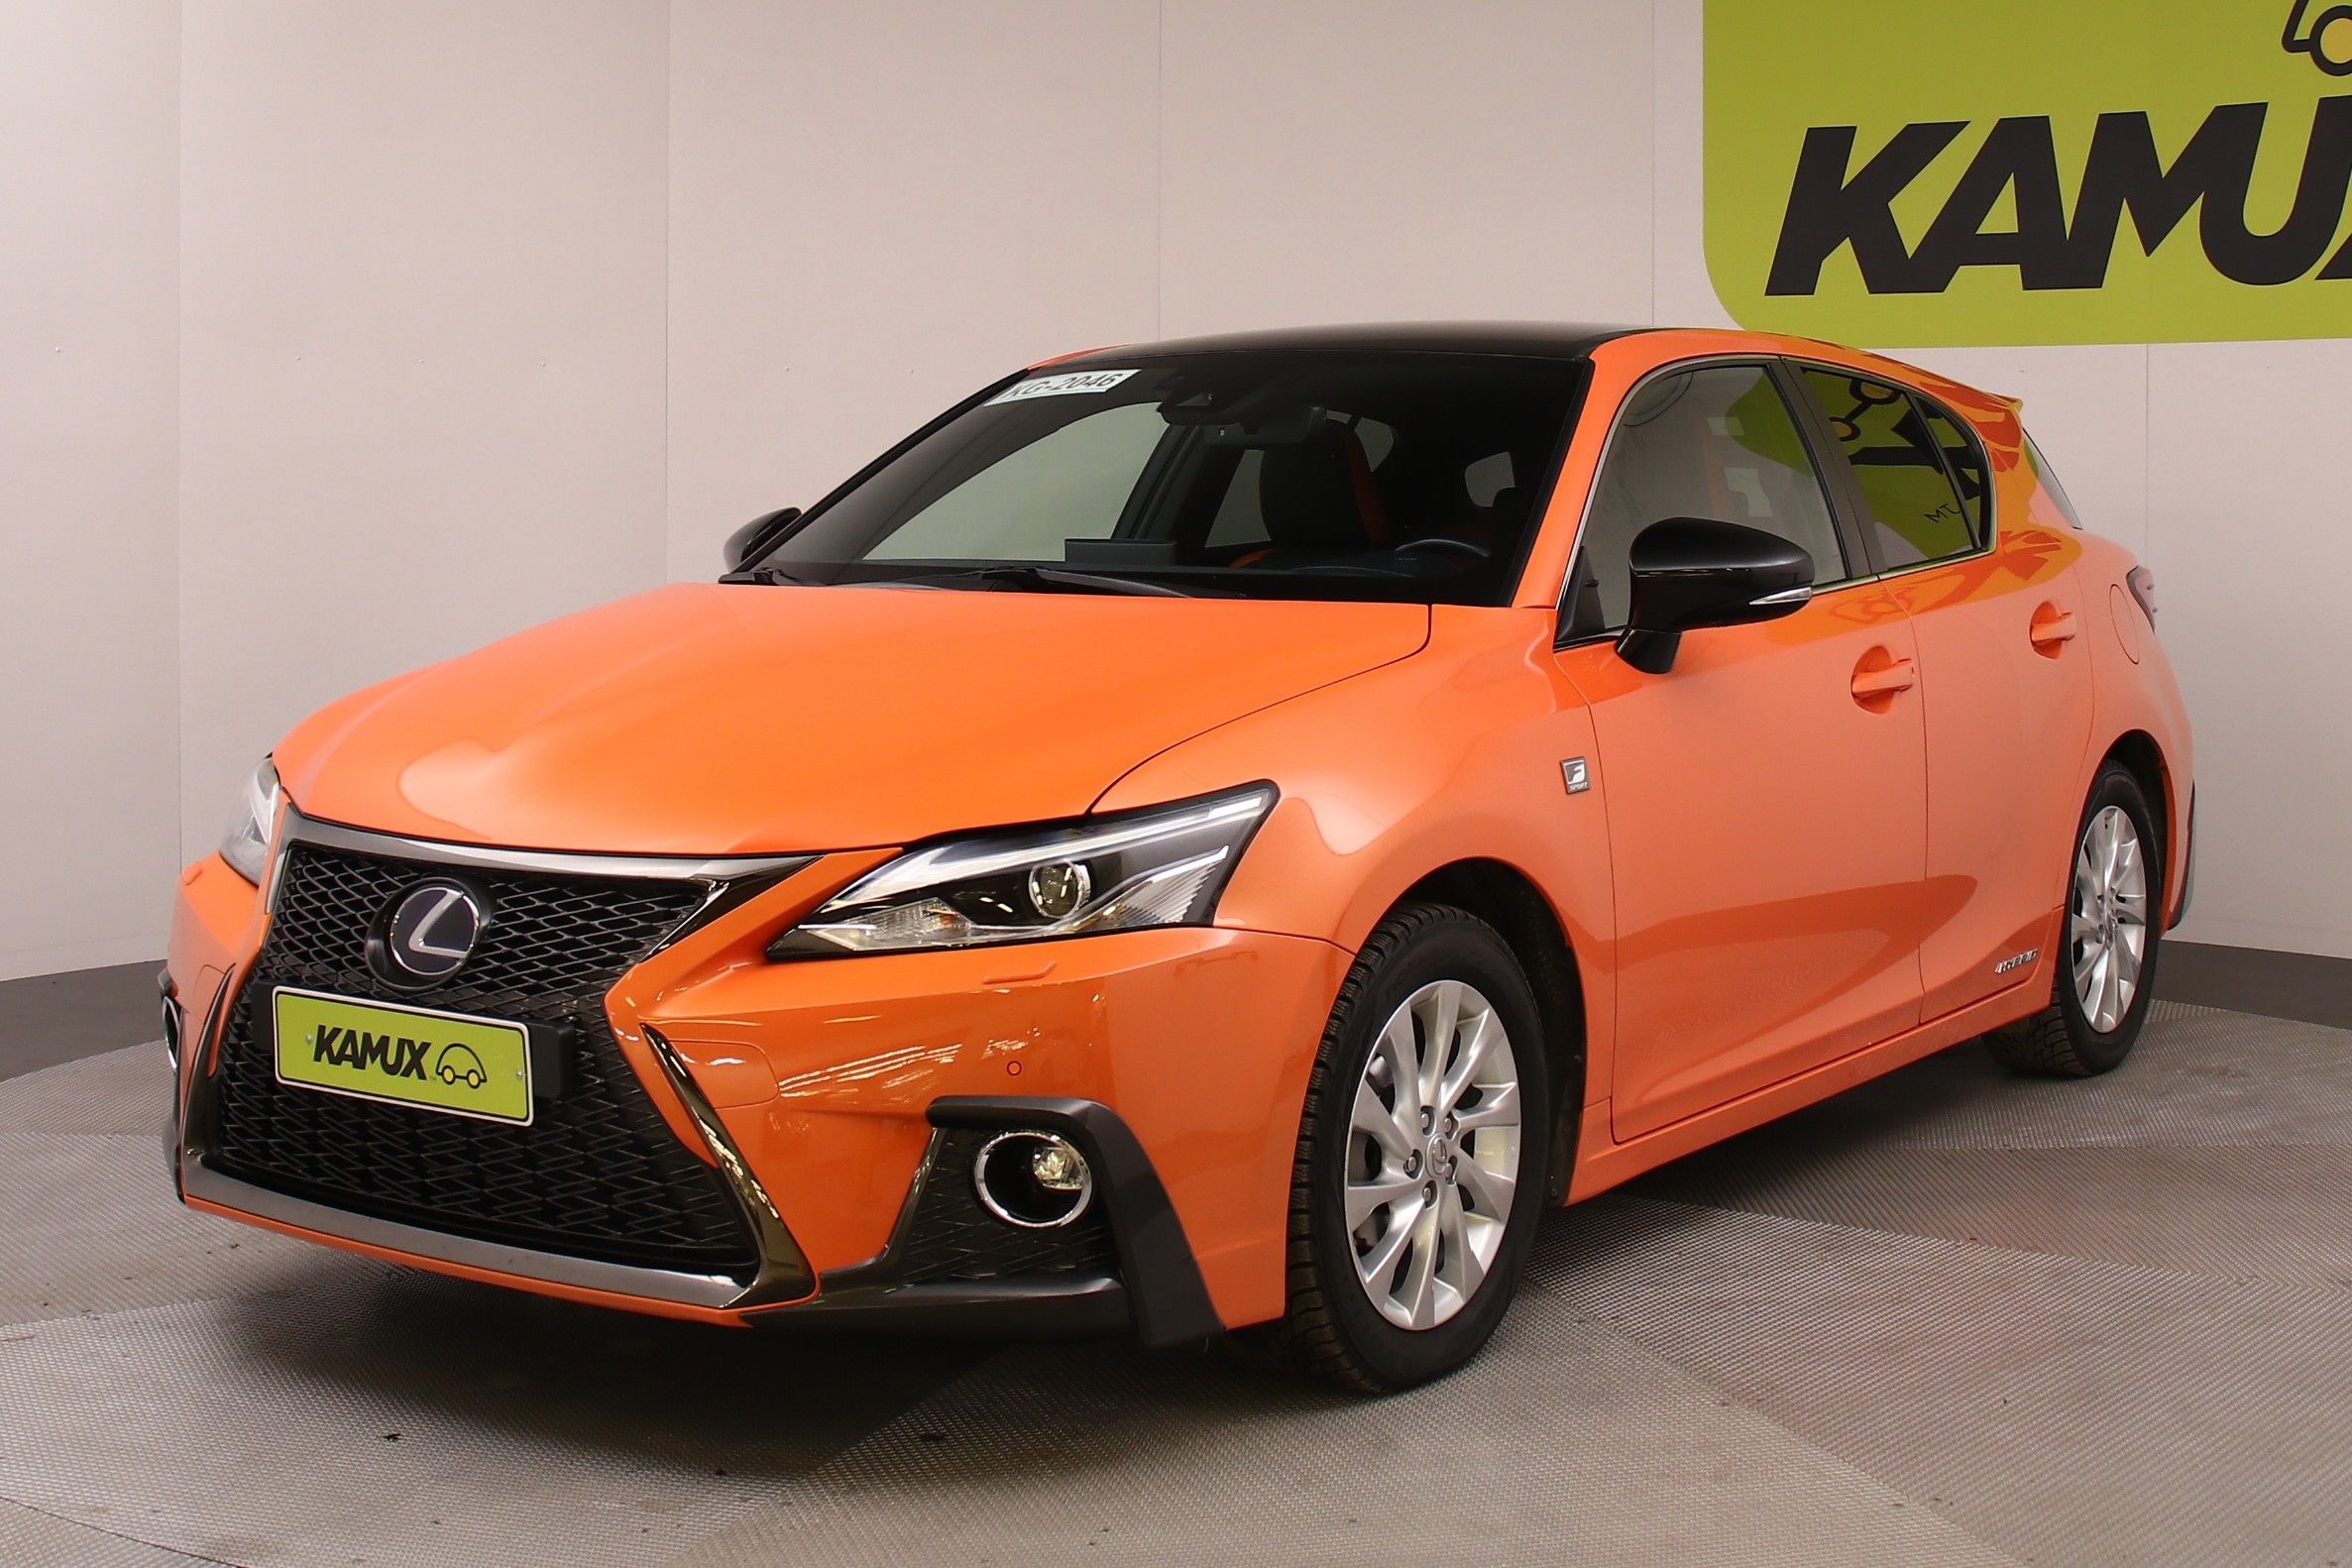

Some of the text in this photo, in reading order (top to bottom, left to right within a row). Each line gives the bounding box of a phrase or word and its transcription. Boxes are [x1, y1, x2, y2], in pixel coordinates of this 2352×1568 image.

[1764, 95, 2352, 296] KAMU
[1008, 373, 1123, 396] KG-2046
[313, 1024, 432, 1081] KAMUX
